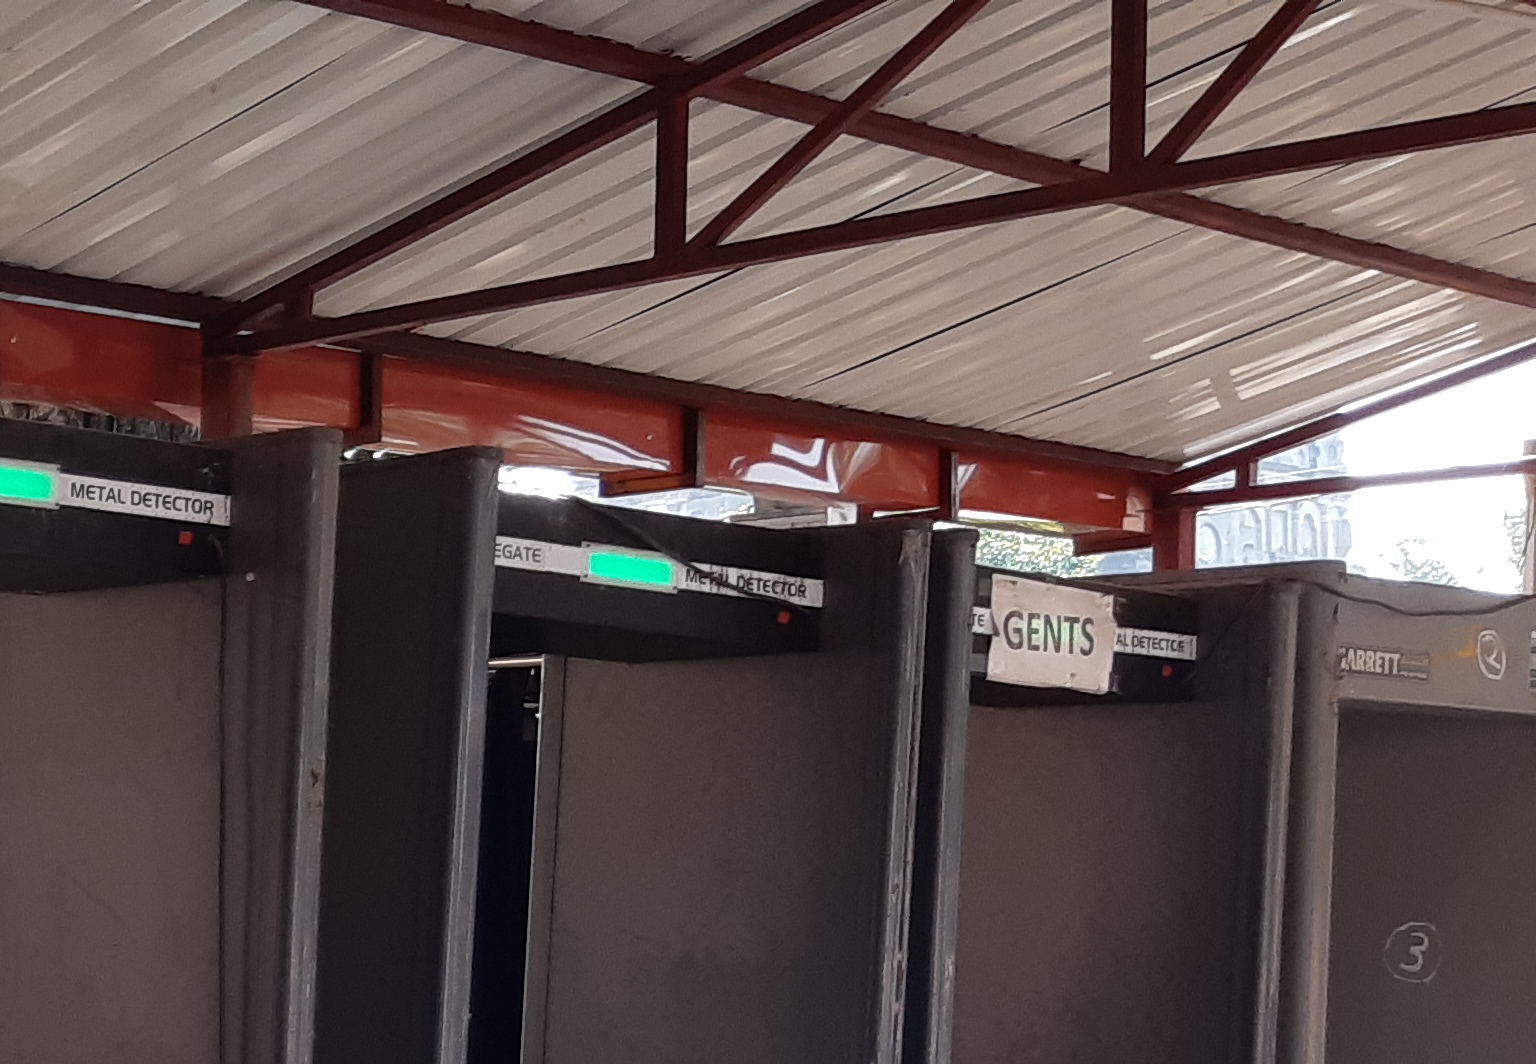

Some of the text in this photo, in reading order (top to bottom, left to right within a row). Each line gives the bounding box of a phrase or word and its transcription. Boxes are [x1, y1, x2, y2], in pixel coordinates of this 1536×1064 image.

[70, 481, 126, 504] METAL
[130, 490, 214, 517] DETECTOR
[736, 574, 808, 598] DETECTOR
[1002, 610, 1095, 656] GENTS
[1399, 932, 1429, 972] 3
